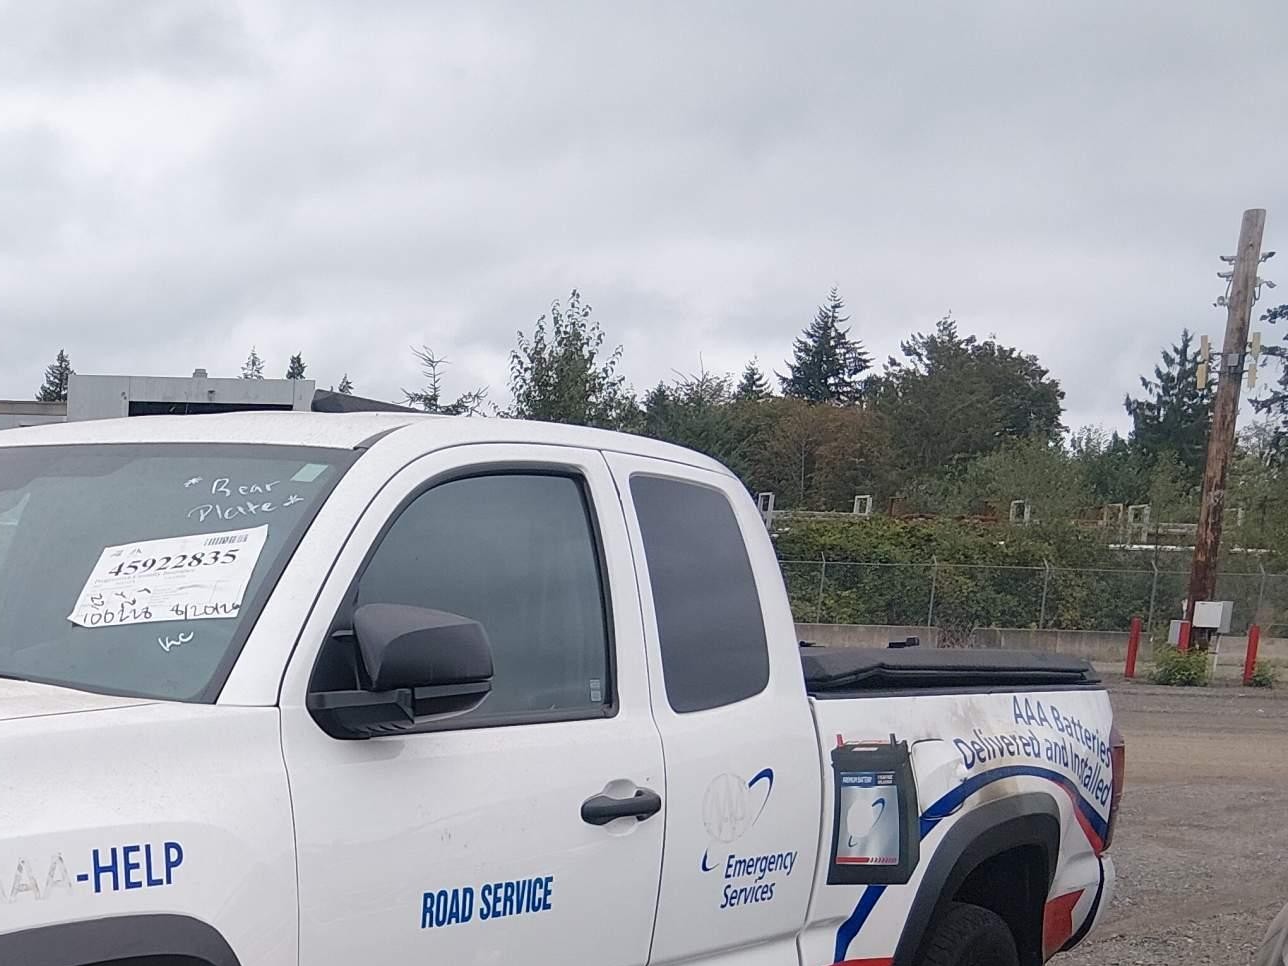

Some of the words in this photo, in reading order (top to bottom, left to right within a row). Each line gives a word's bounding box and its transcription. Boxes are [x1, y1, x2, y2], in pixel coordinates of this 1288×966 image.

[188, 501, 277, 522] Plate
[109, 549, 240, 577] 45922835
[1013, 695, 1050, 726] AAA
[1051, 704, 1112, 769] Batteries
[954, 729, 1041, 770] Delivered
[1045, 737, 1070, 764] and
[1070, 741, 1111, 806] Installed
[724, 851, 798, 883] Emergency
[421, 887, 475, 929] ROAD
[480, 876, 554, 921] SERVICE
[720, 882, 776, 909] Services
